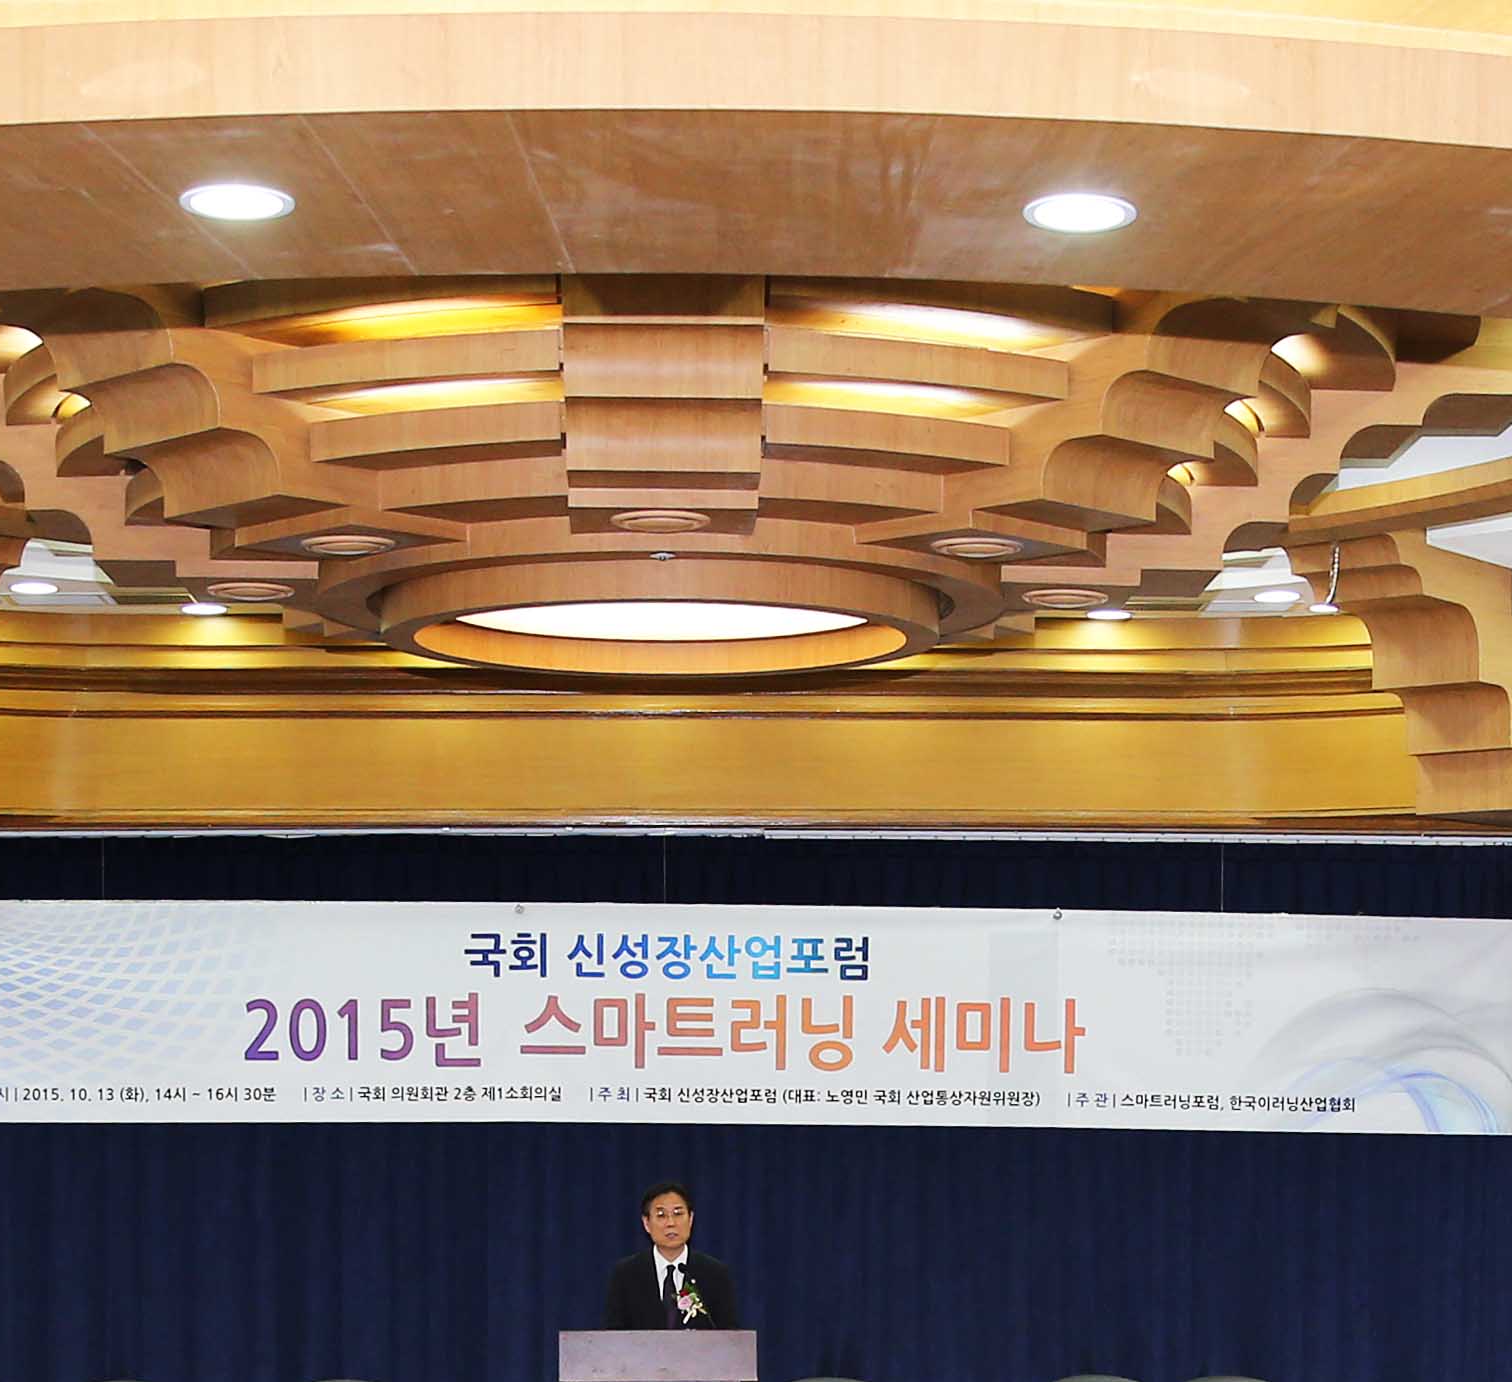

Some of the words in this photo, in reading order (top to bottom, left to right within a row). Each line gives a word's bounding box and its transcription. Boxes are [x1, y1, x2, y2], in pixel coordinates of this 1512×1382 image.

[463, 932, 548, 978] 국회
[566, 933, 870, 981] 신성장산업포럼
[244, 992, 482, 1068] 2015년
[519, 992, 855, 1072] 스마트러닝
[881, 996, 1087, 1074] 세미나
[22, 1087, 64, 1102] 2015.
[70, 1087, 92, 1102] 10.
[97, 1087, 115, 1102] 13
[119, 1086, 149, 1103] (화),
[155, 1087, 186, 1103] 14시
[207, 1086, 238, 1103] 16시
[243, 1086, 277, 1103] 30분
[357, 1086, 386, 1103] 국회
[391, 1085, 449, 1102] 의원회관
[453, 1085, 477, 1102] 2층
[480, 1085, 562, 1103] 제1소회의실
[643, 1087, 672, 1103] 국회
[677, 1087, 777, 1104] 신성장산업포럼
[782, 1088, 821, 1105] (대표:
[825, 1088, 868, 1105] 노영민
[872, 1089, 901, 1105] 국회
[906, 1089, 1041, 1107] 산업통상자원위원장)
[1120, 1093, 1224, 1111] 스마트러닝포럼,
[1229, 1095, 1356, 1113] 한국이러닝산업협회
